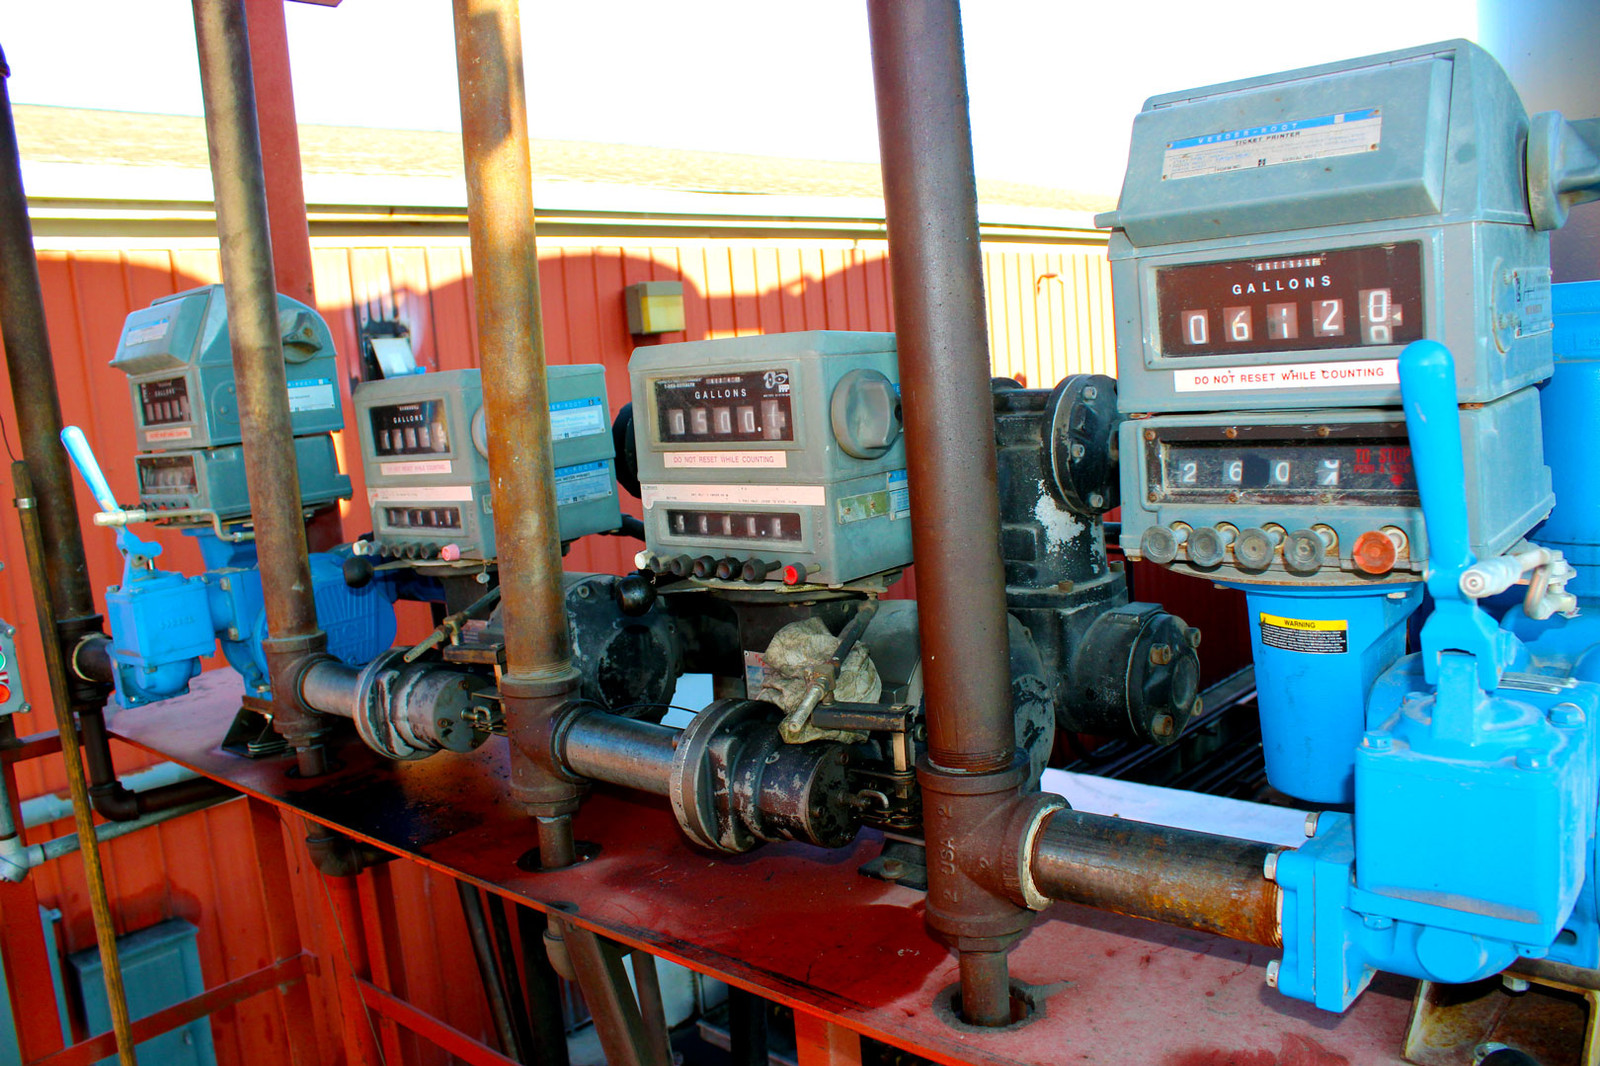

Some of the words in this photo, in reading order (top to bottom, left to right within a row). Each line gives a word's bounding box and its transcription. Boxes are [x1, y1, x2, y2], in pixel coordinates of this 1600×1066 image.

[1198, 122, 1298, 144] VEEDER-ROOT
[1235, 137, 1262, 147] TICKET
[1266, 131, 1300, 141] PRINTER
[1232, 275, 1331, 296] GALLONS
[1194, 376, 1209, 385] DO
[1213, 374, 1236, 384] NOT
[1240, 373, 1276, 383] RESET
[1281, 370, 1316, 381] WHILE
[1322, 367, 1385, 379] COUNTING
[694, 388, 747, 400] GALLONS
[393, 414, 423, 424] GALLONS
[673, 456, 682, 464] DO
[684, 456, 696, 464] NOT
[699, 456, 717, 464] RESET
[720, 455, 739, 463] WHILE
[742, 455, 775, 464] COUNTING
[1355, 448, 1371, 464] TO
[1378, 446, 1411, 464] STOP
[1284, 619, 1316, 629] WARNING
[940, 837, 955, 875] USA
